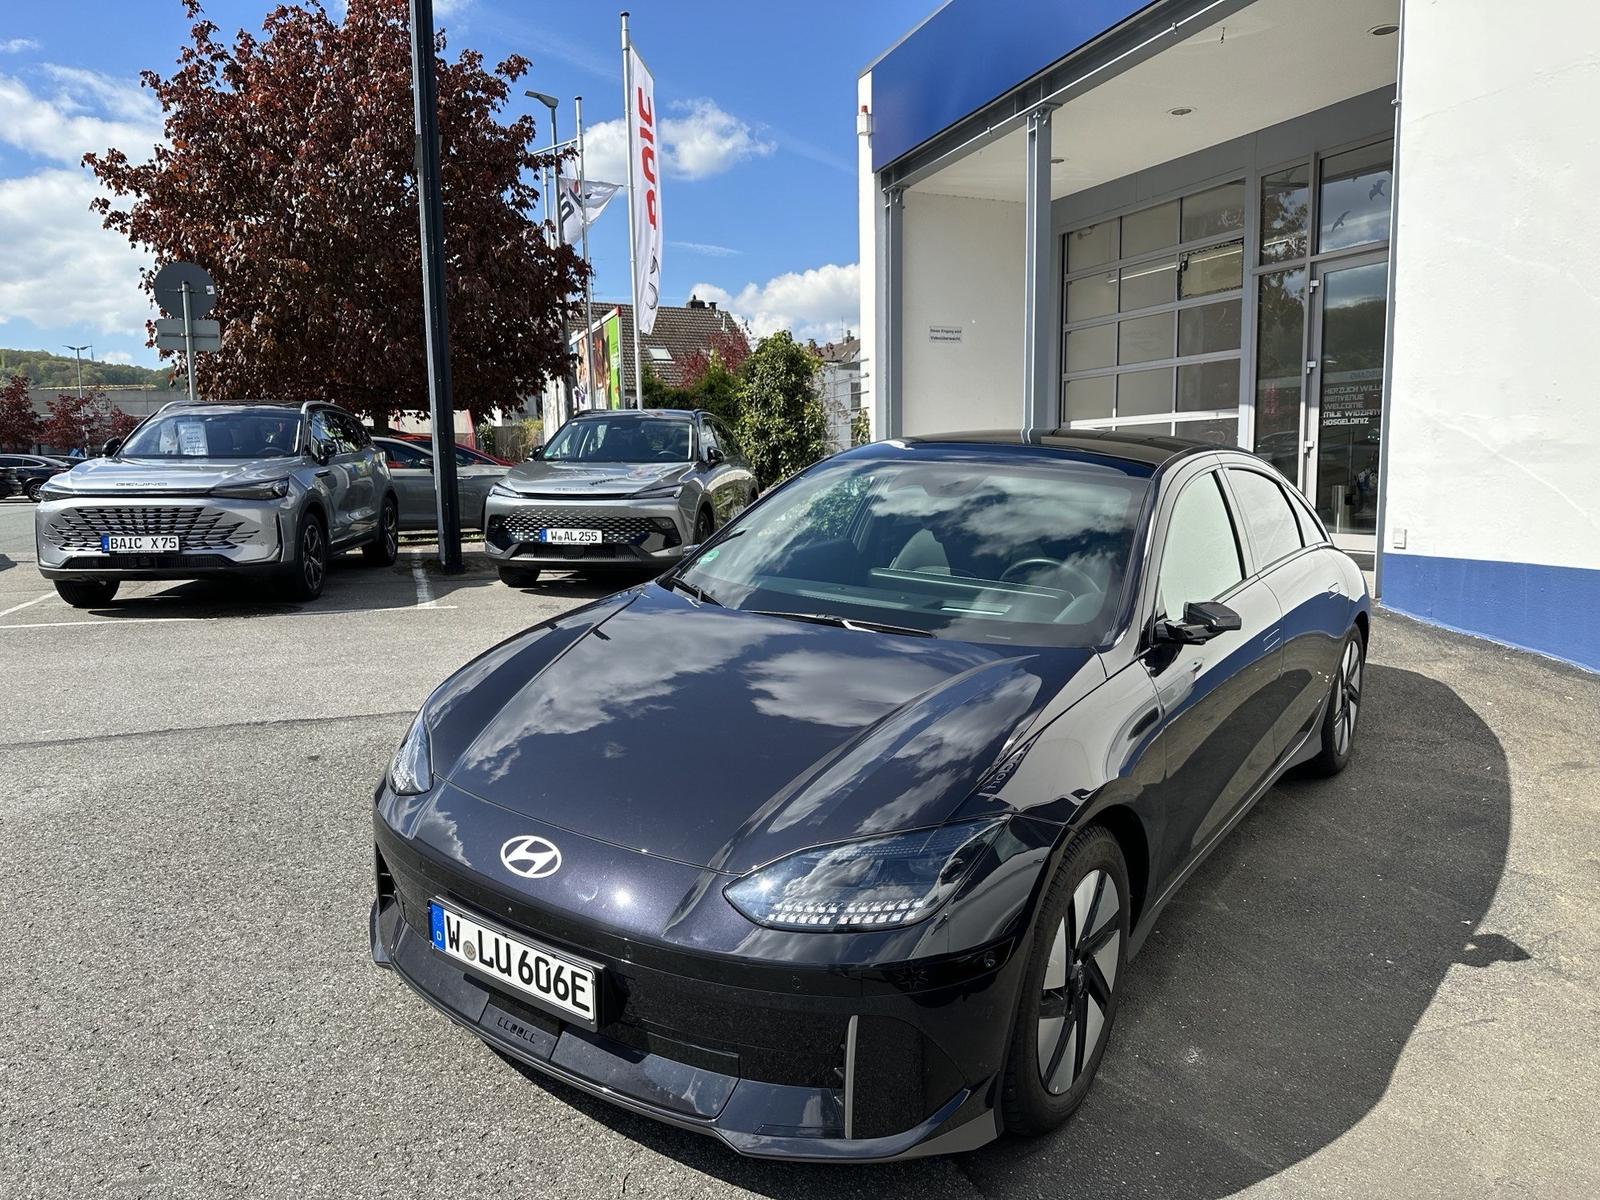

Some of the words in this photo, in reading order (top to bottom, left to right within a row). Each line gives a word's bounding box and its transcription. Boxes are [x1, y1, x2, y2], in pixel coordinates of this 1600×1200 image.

[1324, 401, 1364, 410] WELCOME
[550, 531, 558, 541] W
[110, 537, 142, 549] BAIC
[446, 915, 461, 952] W
